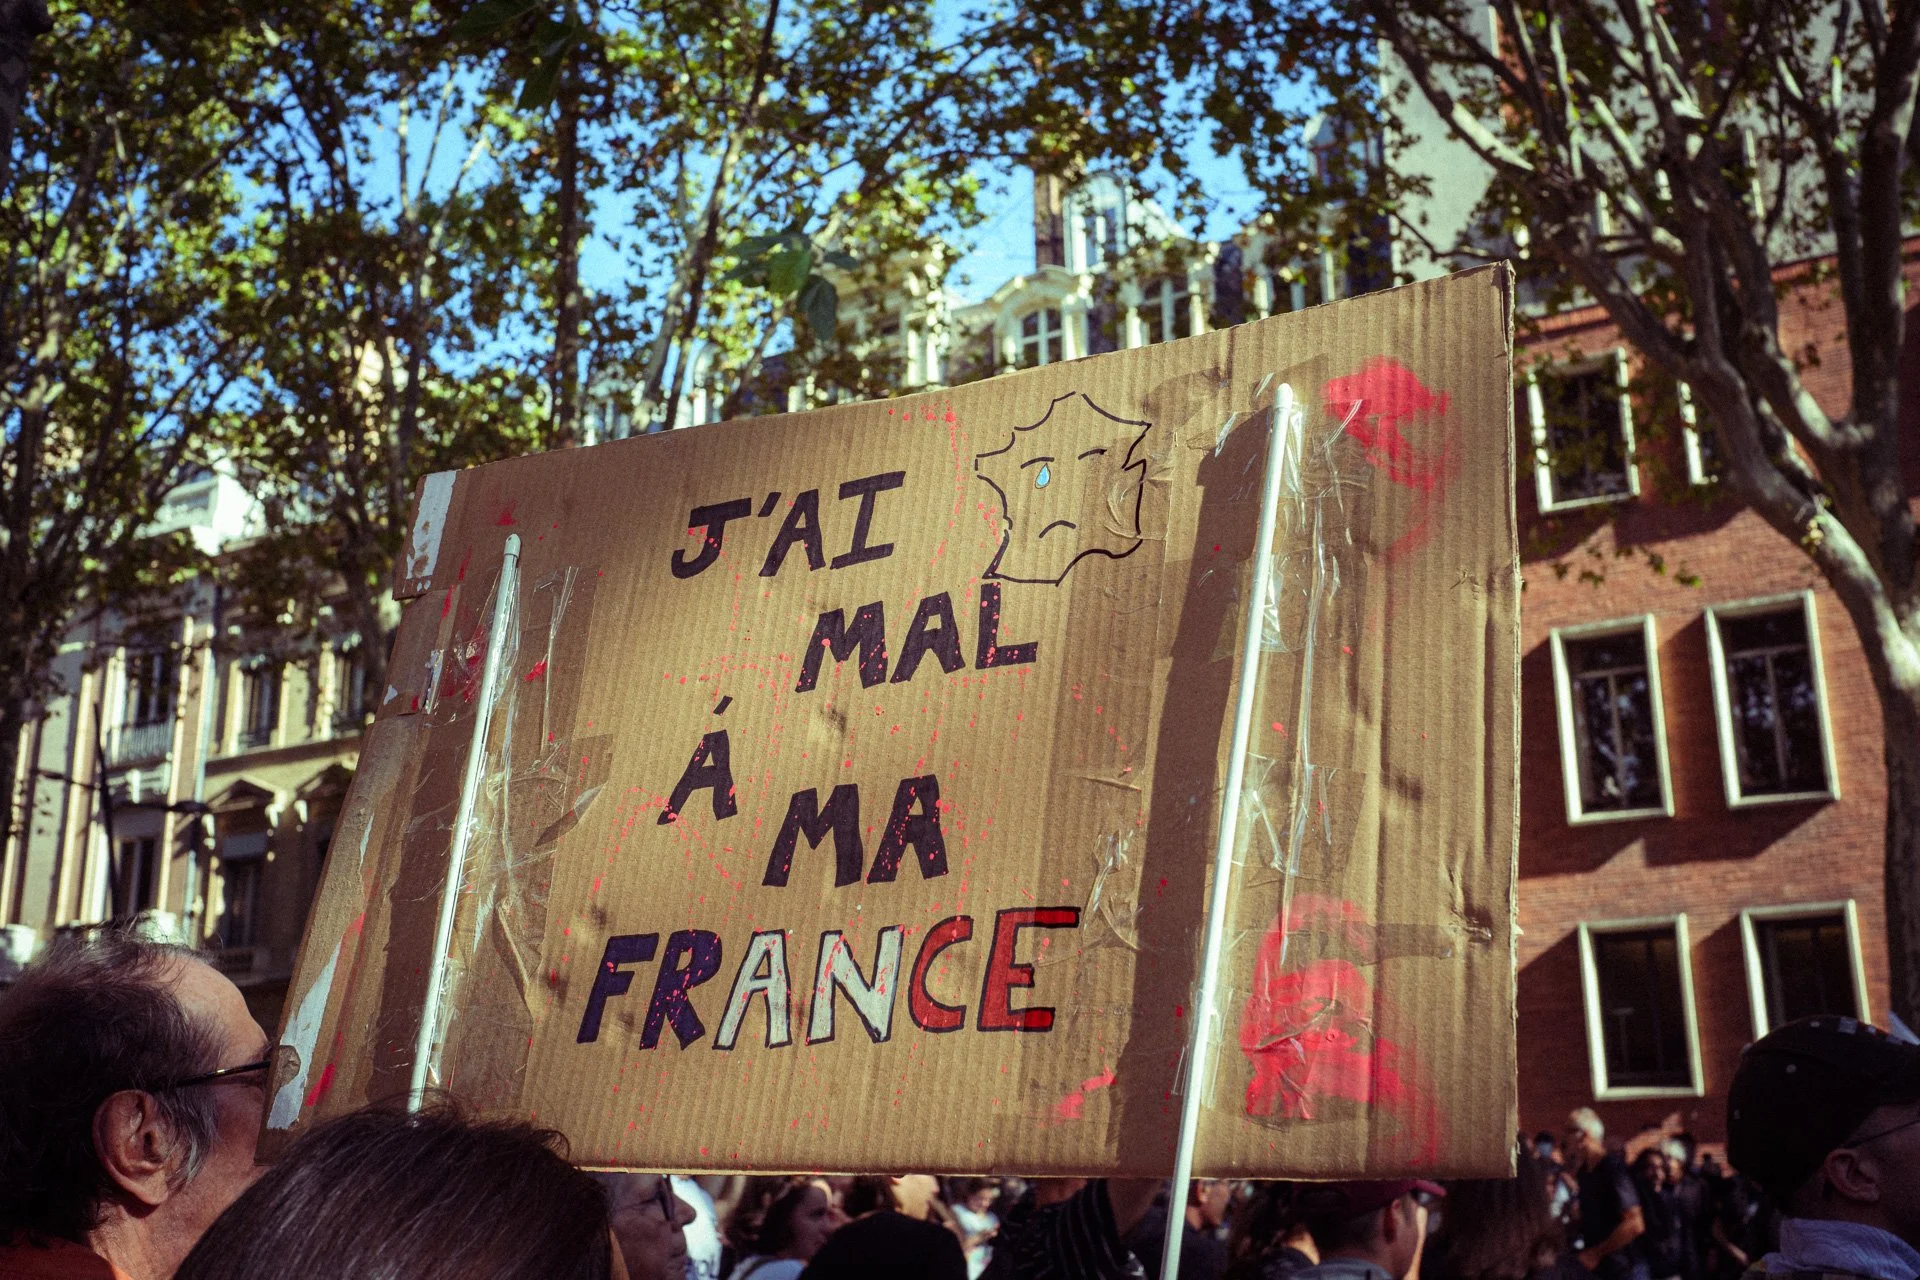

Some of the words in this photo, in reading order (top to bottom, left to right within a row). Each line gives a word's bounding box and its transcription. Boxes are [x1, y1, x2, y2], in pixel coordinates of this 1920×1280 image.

[671, 471, 905, 579] J'AI
[796, 582, 1037, 692] MAL
[763, 773, 949, 887] MA
[577, 906, 1081, 1050] FRANCE
